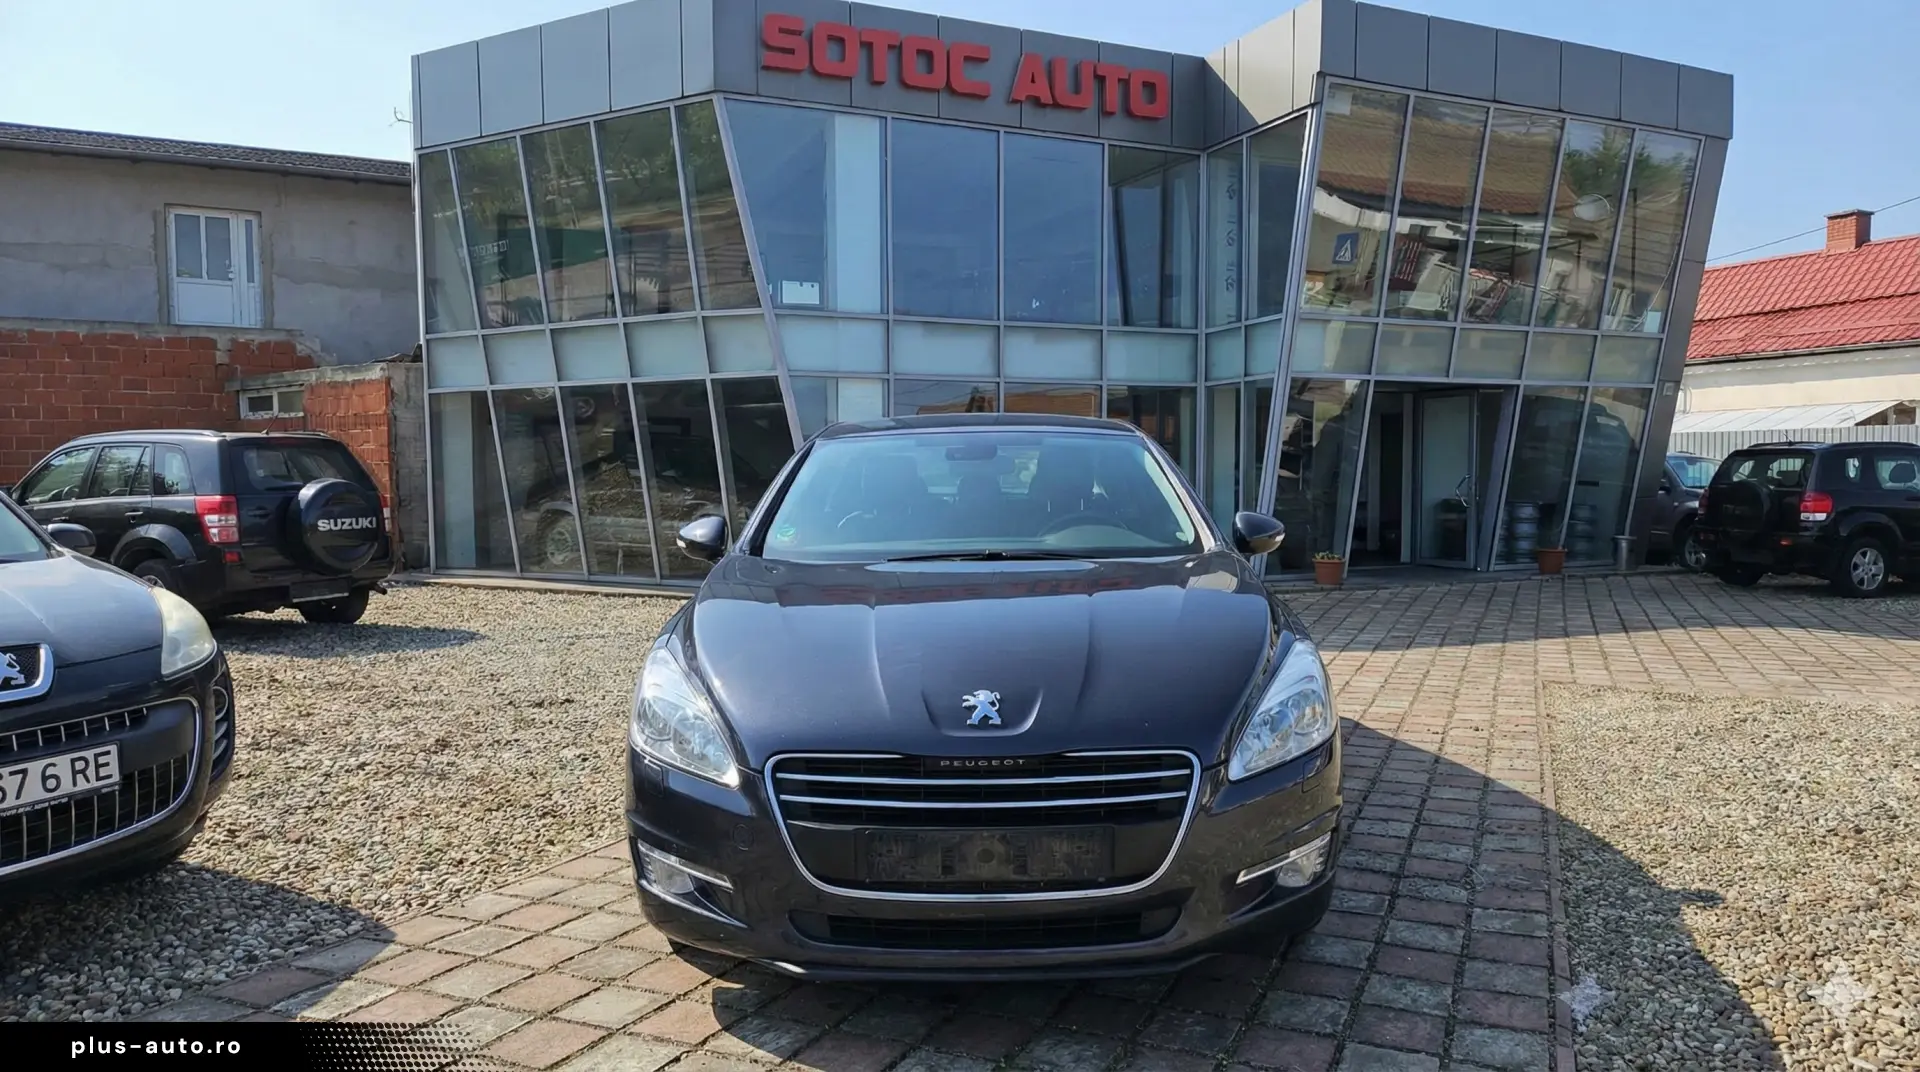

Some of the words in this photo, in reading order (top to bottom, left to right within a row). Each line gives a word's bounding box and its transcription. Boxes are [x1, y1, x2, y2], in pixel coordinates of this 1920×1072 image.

[761, 13, 991, 98] SOTOC
[1009, 53, 1168, 118] AUTO
[317, 516, 377, 532] SUZUKI
[69, 750, 114, 788] RE
[940, 759, 1026, 767] PEUGEOT
